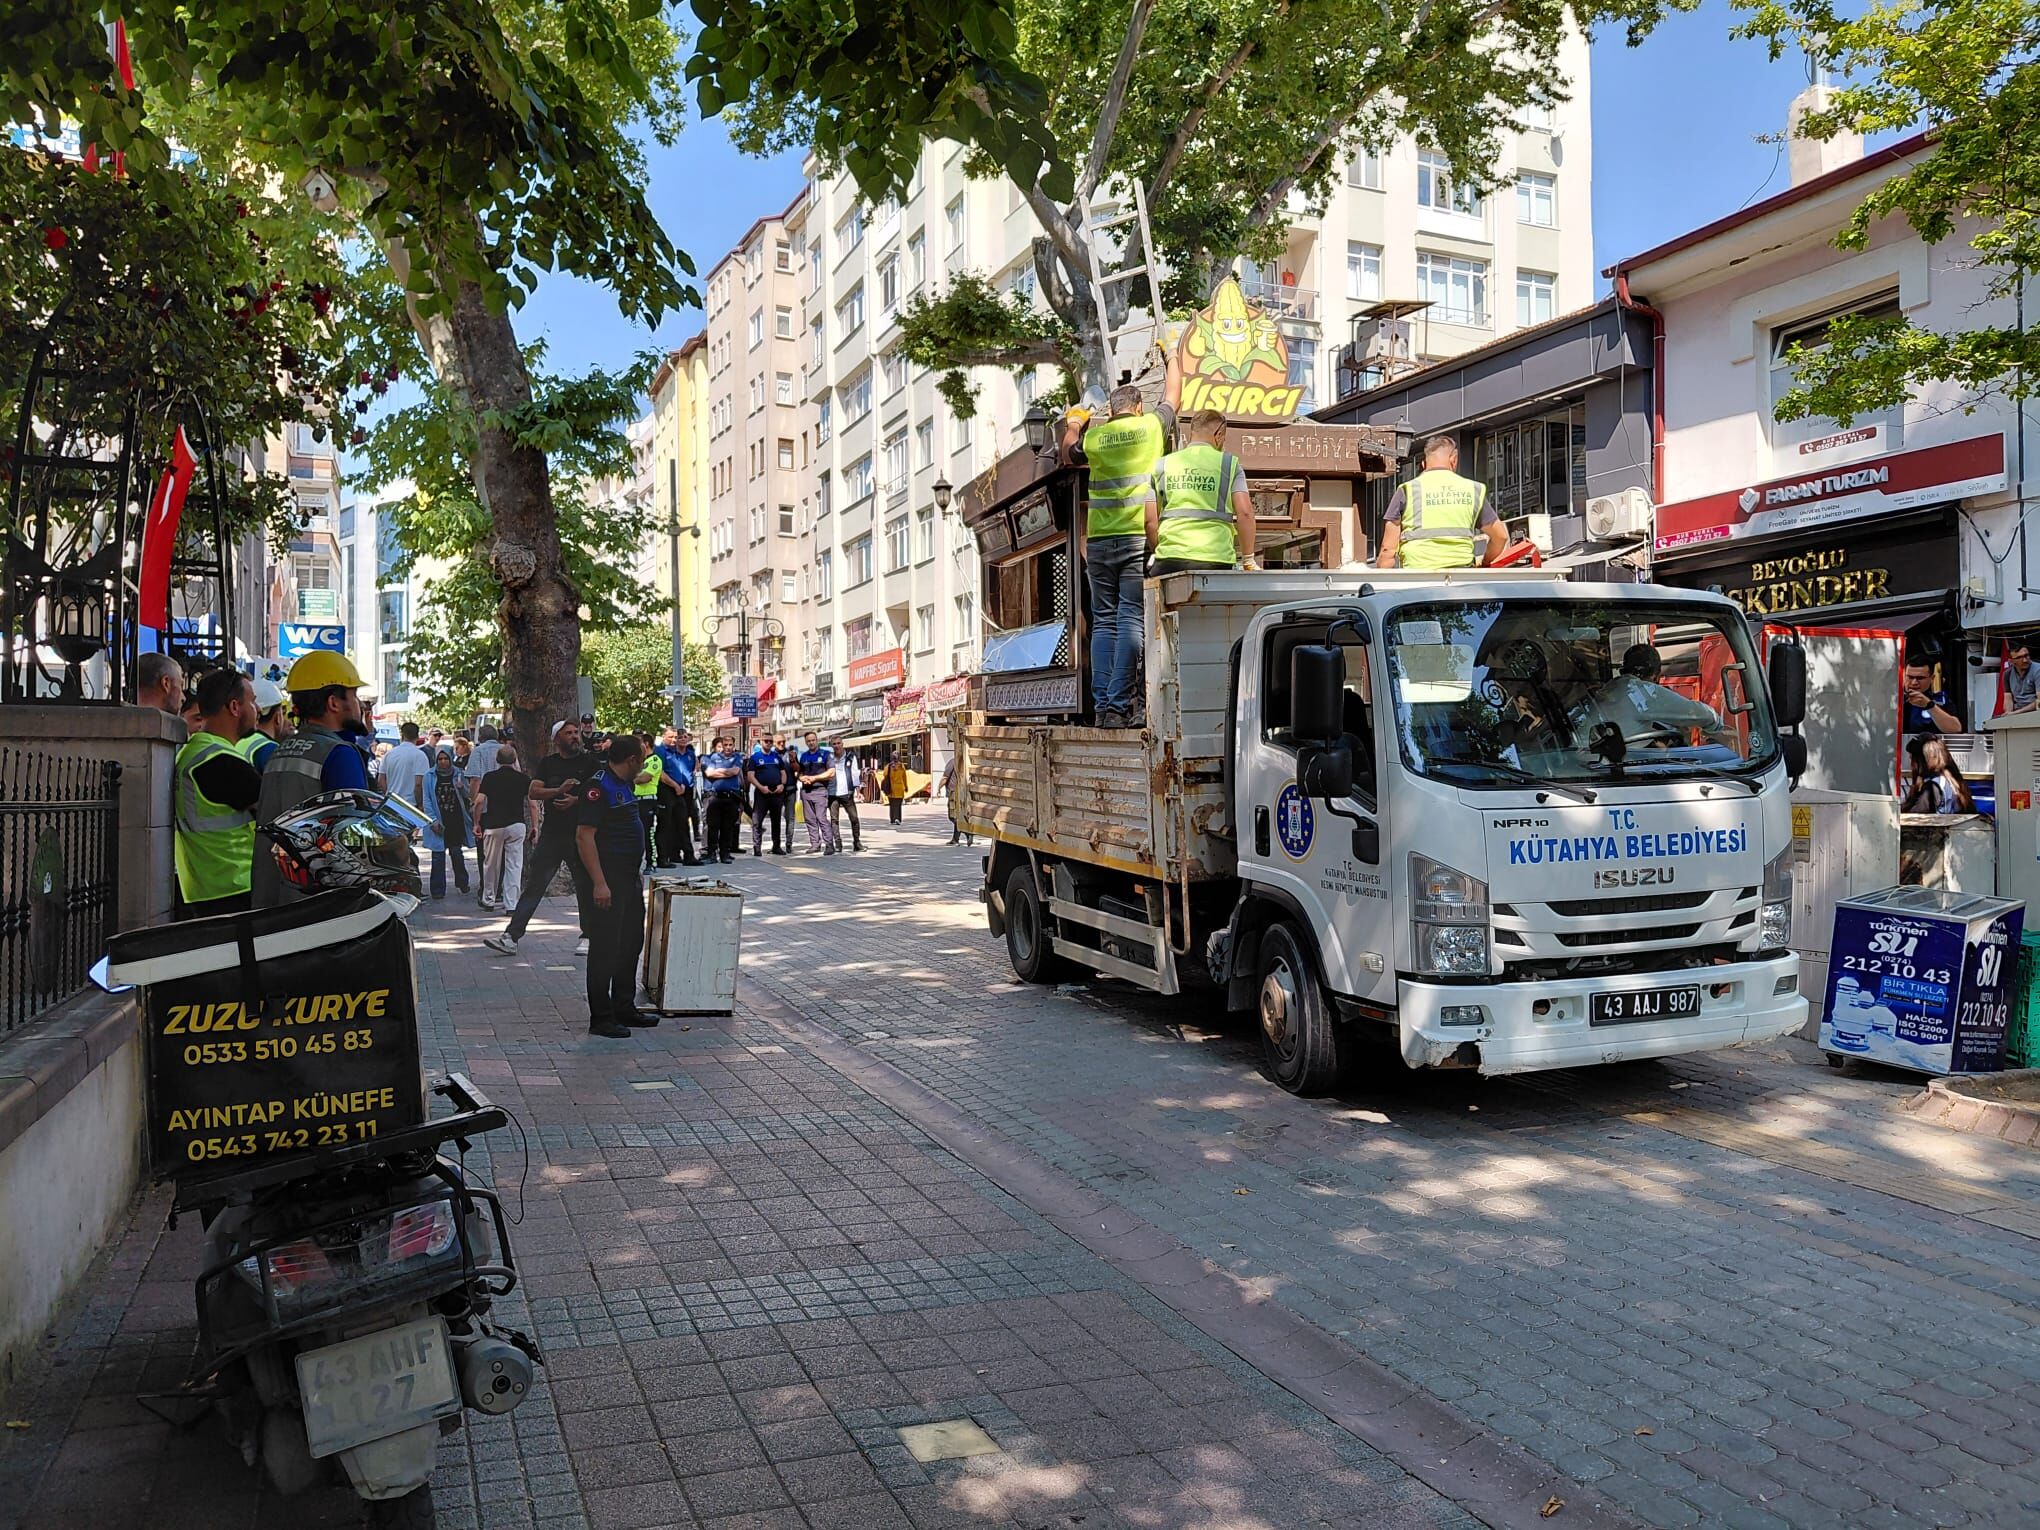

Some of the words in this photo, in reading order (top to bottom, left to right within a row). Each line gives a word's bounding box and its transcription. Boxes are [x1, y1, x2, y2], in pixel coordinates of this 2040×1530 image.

[1765, 479, 1822, 505] FARAN
[1768, 517, 1798, 529] FreeGate
[1751, 549, 1846, 582] BEYOĞLU
[1726, 568, 1891, 614] SKENDER
[284, 626, 340, 645] WC
[877, 659, 897, 677] Sigorta
[1493, 818, 1532, 829] NPR
[1534, 819, 1549, 827] 10
[1609, 809, 1639, 830] T.C.
[1509, 834, 1619, 865] KÜTAHYA
[1626, 823, 1747, 858] BELEDİYESİ
[1594, 866, 1675, 889] ISUZU
[1843, 955, 1882, 974] 212
[1889, 963, 1916, 979] 10
[1922, 969, 1951, 984] 43
[1881, 955, 1912, 966] (0274)
[1883, 978, 1905, 989] BİR
[1909, 982, 1945, 996] TIKLA
[163, 1000, 263, 1035] ZUZU
[272, 989, 390, 1027] KURYE
[1604, 996, 1623, 1017] 43
[1633, 993, 1660, 1016] AAJ
[1669, 990, 1697, 1012] 987
[1961, 1002, 1980, 1026] 212
[1980, 1003, 1994, 1026] 10
[1994, 1004, 2008, 1028] 43
[1898, 1020, 1917, 1029] ISO
[1918, 1023, 1949, 1035] 22000
[1905, 1013, 1943, 1025] HACCP
[183, 1041, 248, 1065] 0533
[255, 1037, 298, 1060] 510
[305, 1033, 336, 1054] 45
[343, 1029, 373, 1051] 83
[1900, 1028, 1918, 1037] ISO
[1920, 1032, 1944, 1042] 9001
[167, 1101, 285, 1132] AYINTAP
[294, 1087, 395, 1120] KÜNEFE
[187, 1134, 257, 1161] 0543
[264, 1129, 310, 1152] 742
[317, 1124, 348, 1145] 23
[356, 1119, 377, 1139] 11
[370, 1328, 435, 1375] AHF
